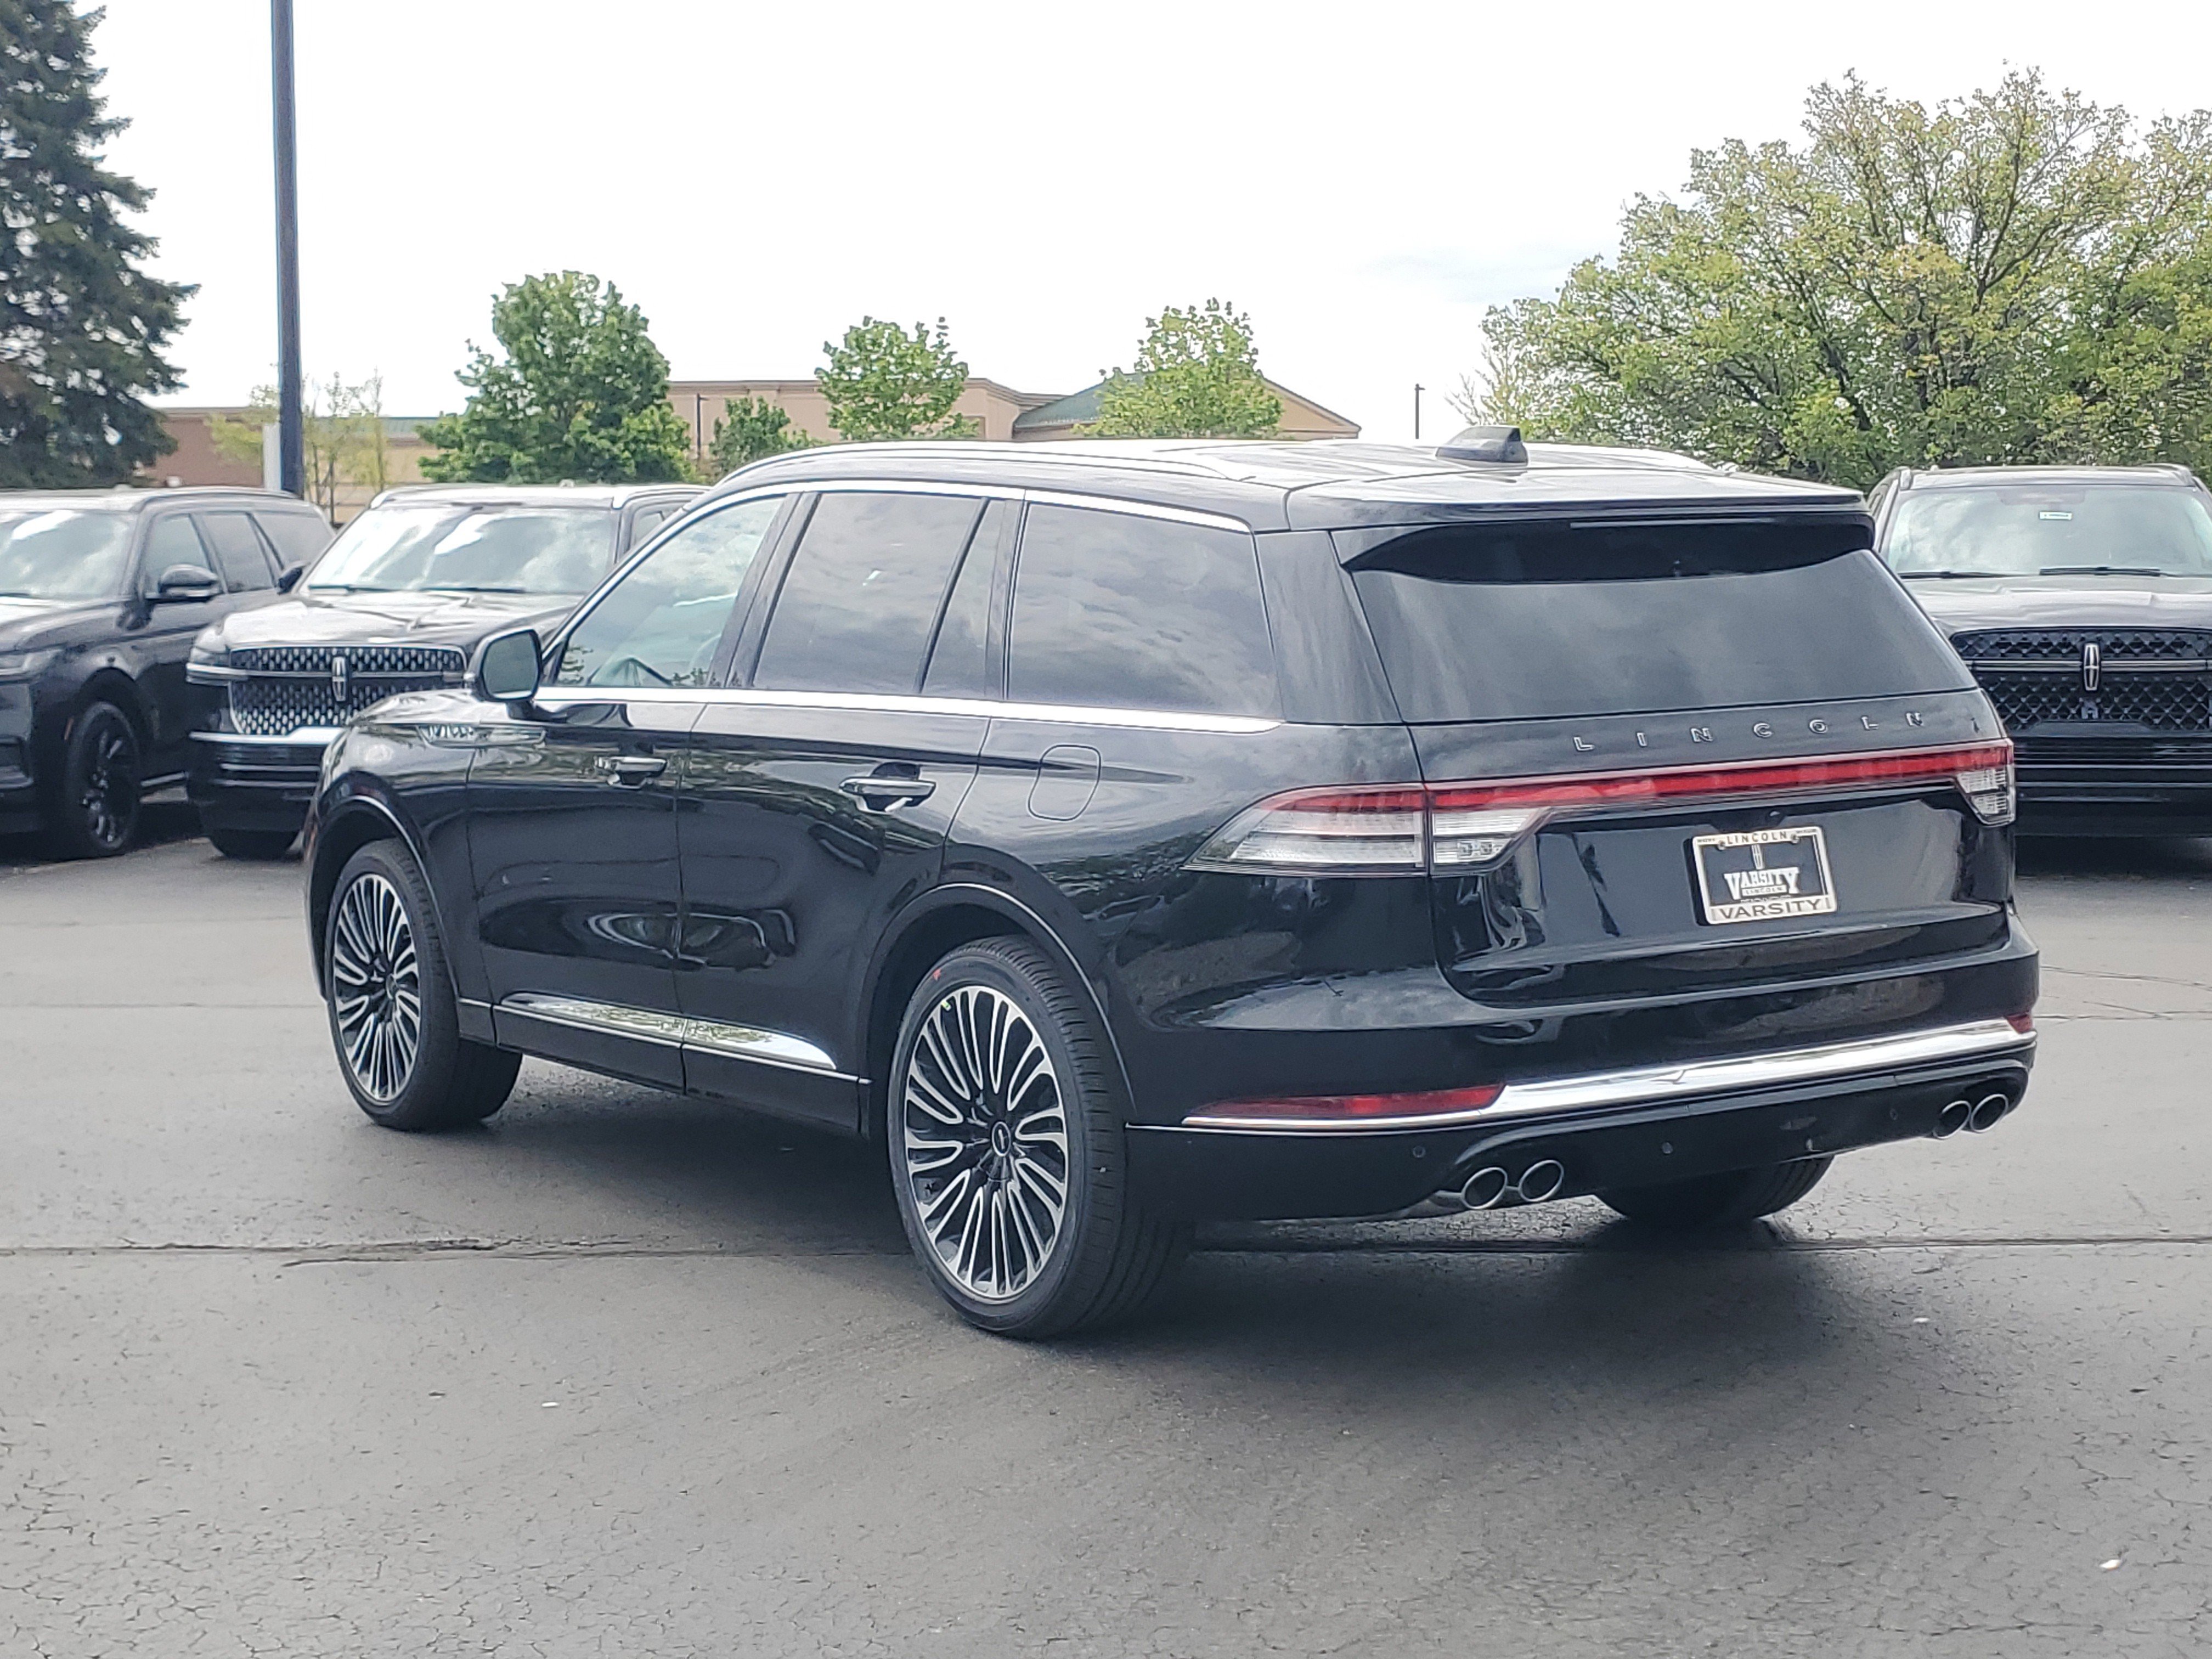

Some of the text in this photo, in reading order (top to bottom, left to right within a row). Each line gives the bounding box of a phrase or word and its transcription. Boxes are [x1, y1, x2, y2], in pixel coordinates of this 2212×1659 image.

[1573, 712, 1924, 752] LINCOLN
[1727, 831, 1787, 845] LINCOLN
[1723, 867, 1799, 900] VARSITY
[1746, 887, 1782, 895] LINCOLN
[1719, 899, 1821, 919] VARSITY
